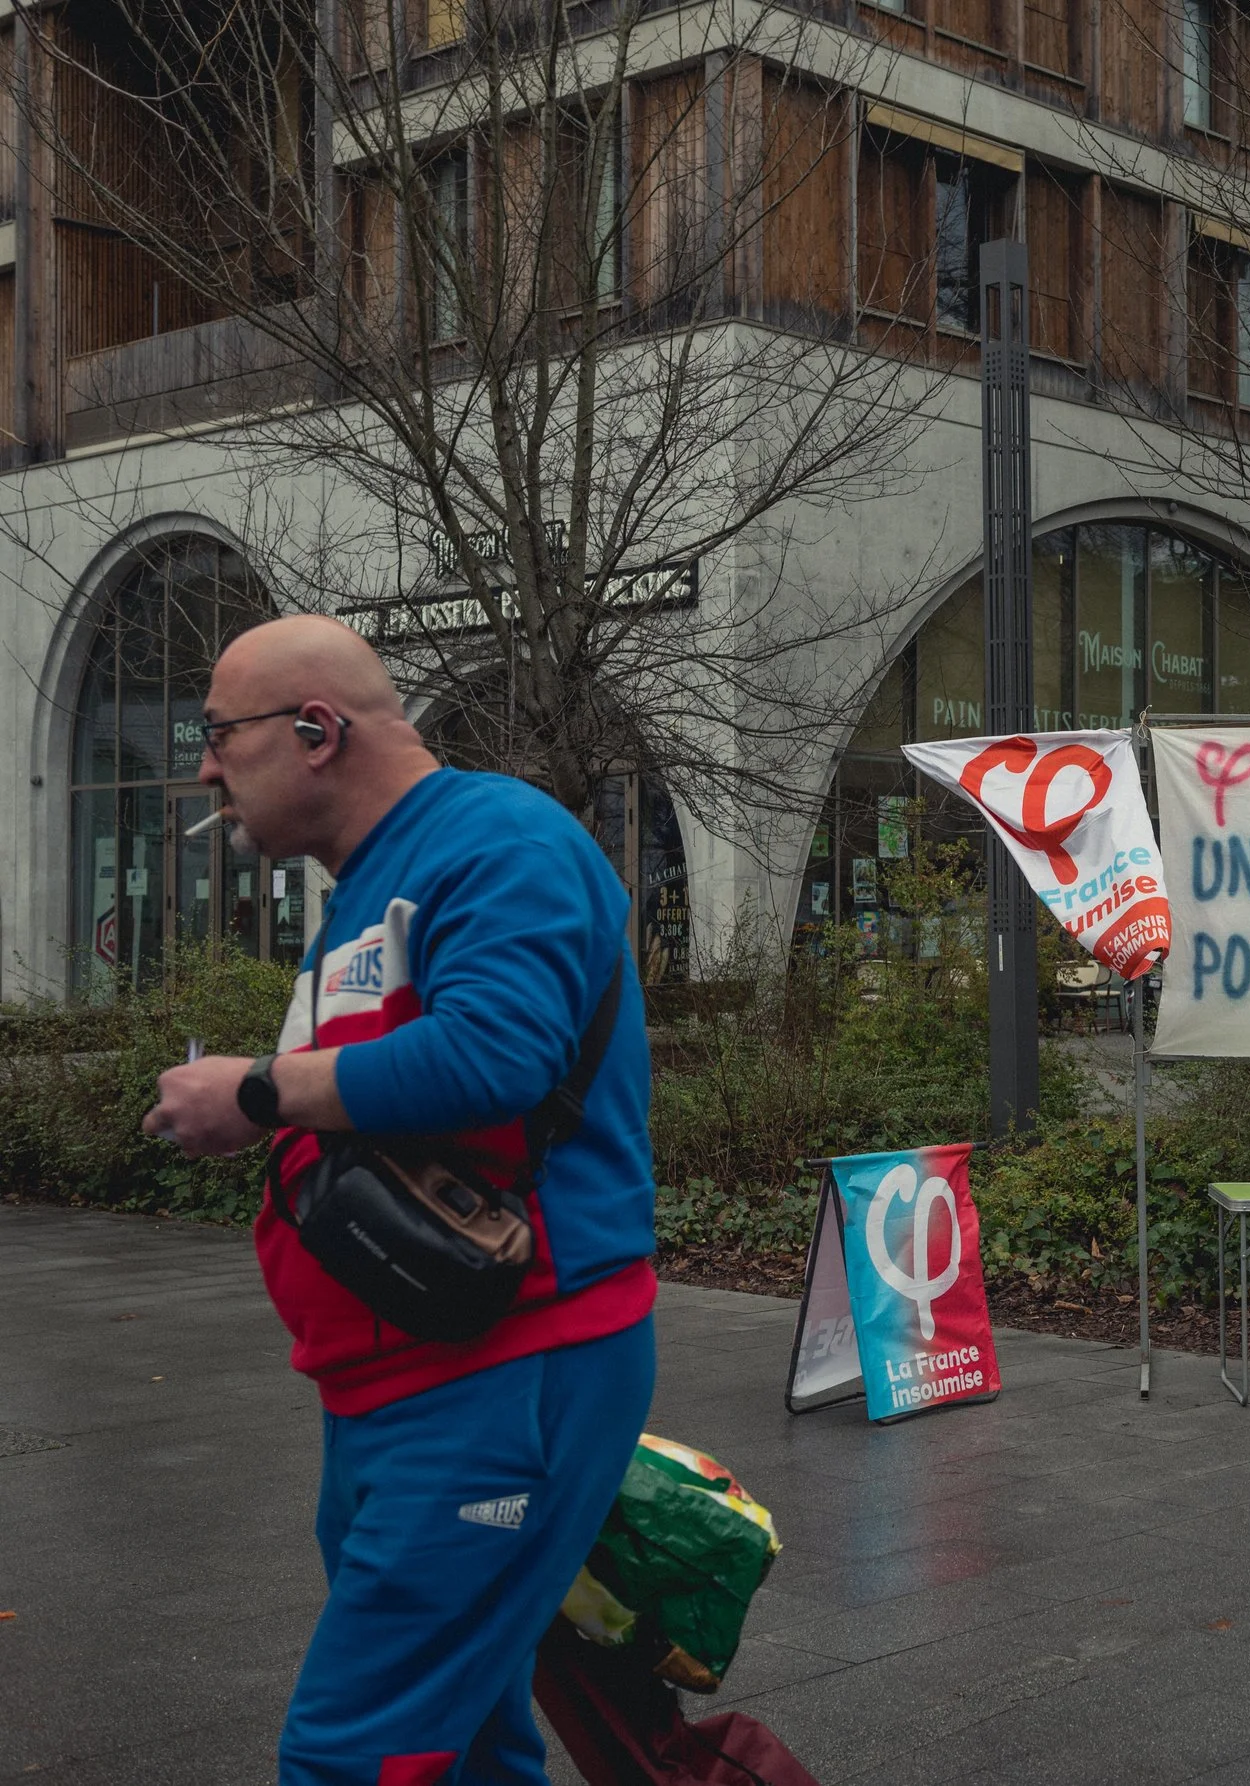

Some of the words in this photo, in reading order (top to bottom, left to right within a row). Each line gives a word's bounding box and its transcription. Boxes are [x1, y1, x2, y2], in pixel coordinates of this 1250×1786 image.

[174, 719, 207, 743] Rés
[933, 698, 981, 729] PAIN
[1065, 875, 1158, 940] umise
[1104, 914, 1168, 957] L'AVENIR
[1113, 927, 1169, 970] COMMUN
[886, 1359, 912, 1382] La
[915, 1345, 979, 1375] France
[891, 1368, 983, 1408] insoumise
